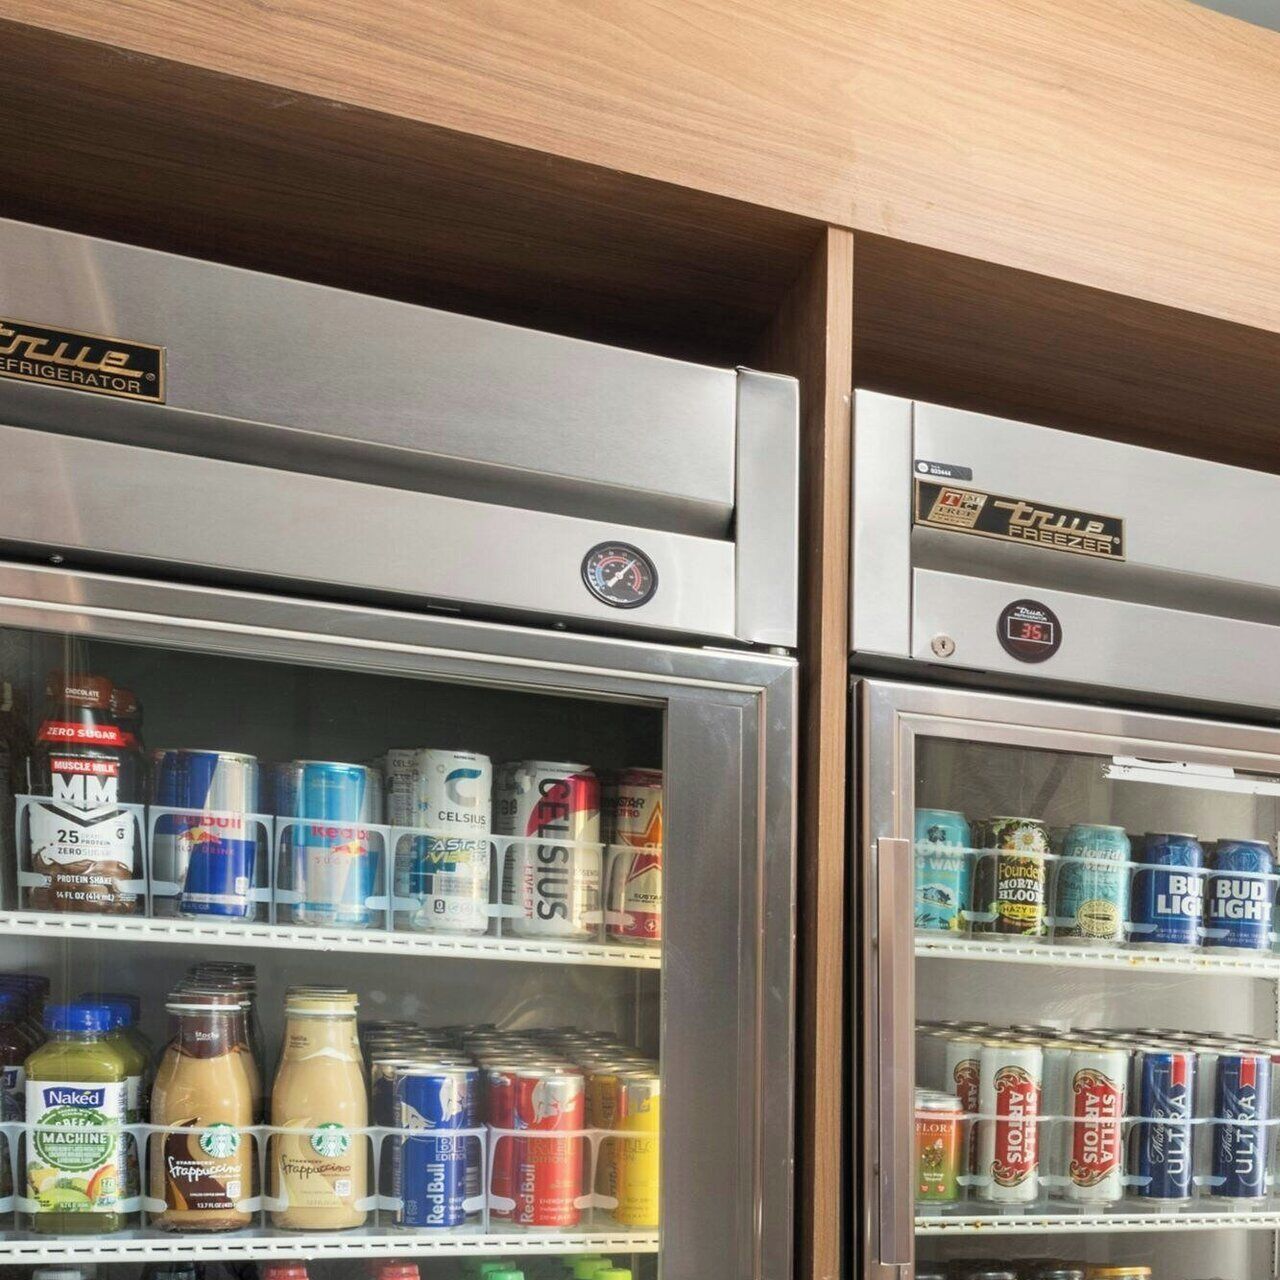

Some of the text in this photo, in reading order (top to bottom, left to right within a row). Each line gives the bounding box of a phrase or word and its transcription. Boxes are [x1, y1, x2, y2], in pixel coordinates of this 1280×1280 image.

[0, 357, 140, 393] EFRIGERATOR
[1009, 525, 1112, 554] FREEZER
[65, 687, 100, 698] CHOCOLATE
[47, 727, 117, 740] ZERO SUGAR
[54, 760, 115, 773] MUSCLE MILK
[438, 810, 486, 825] CELSIUS
[57, 829, 79, 844] 25
[57, 846, 82, 856] ZERO
[537, 778, 571, 921] CELSIUS
[57, 874, 113, 886] PROTEIN SHAKE
[525, 864, 534, 895] LIVE
[1216, 879, 1267, 899] BUD
[65, 891, 85, 901] FL OZ
[1210, 899, 1272, 920] LIGHT
[50, 1091, 99, 1106] Naked
[1006, 1092, 1021, 1163] ARTOIS
[1083, 1093, 1099, 1164] ARTOIS
[1100, 1094, 1116, 1164] STELLA
[1167, 1094, 1187, 1174] ULTRA
[1235, 1092, 1256, 1174] ULTRA
[43, 1132, 107, 1145] MACHINE
[427, 1164, 444, 1223] Red Bull
[520, 1164, 536, 1223] Red Bull
